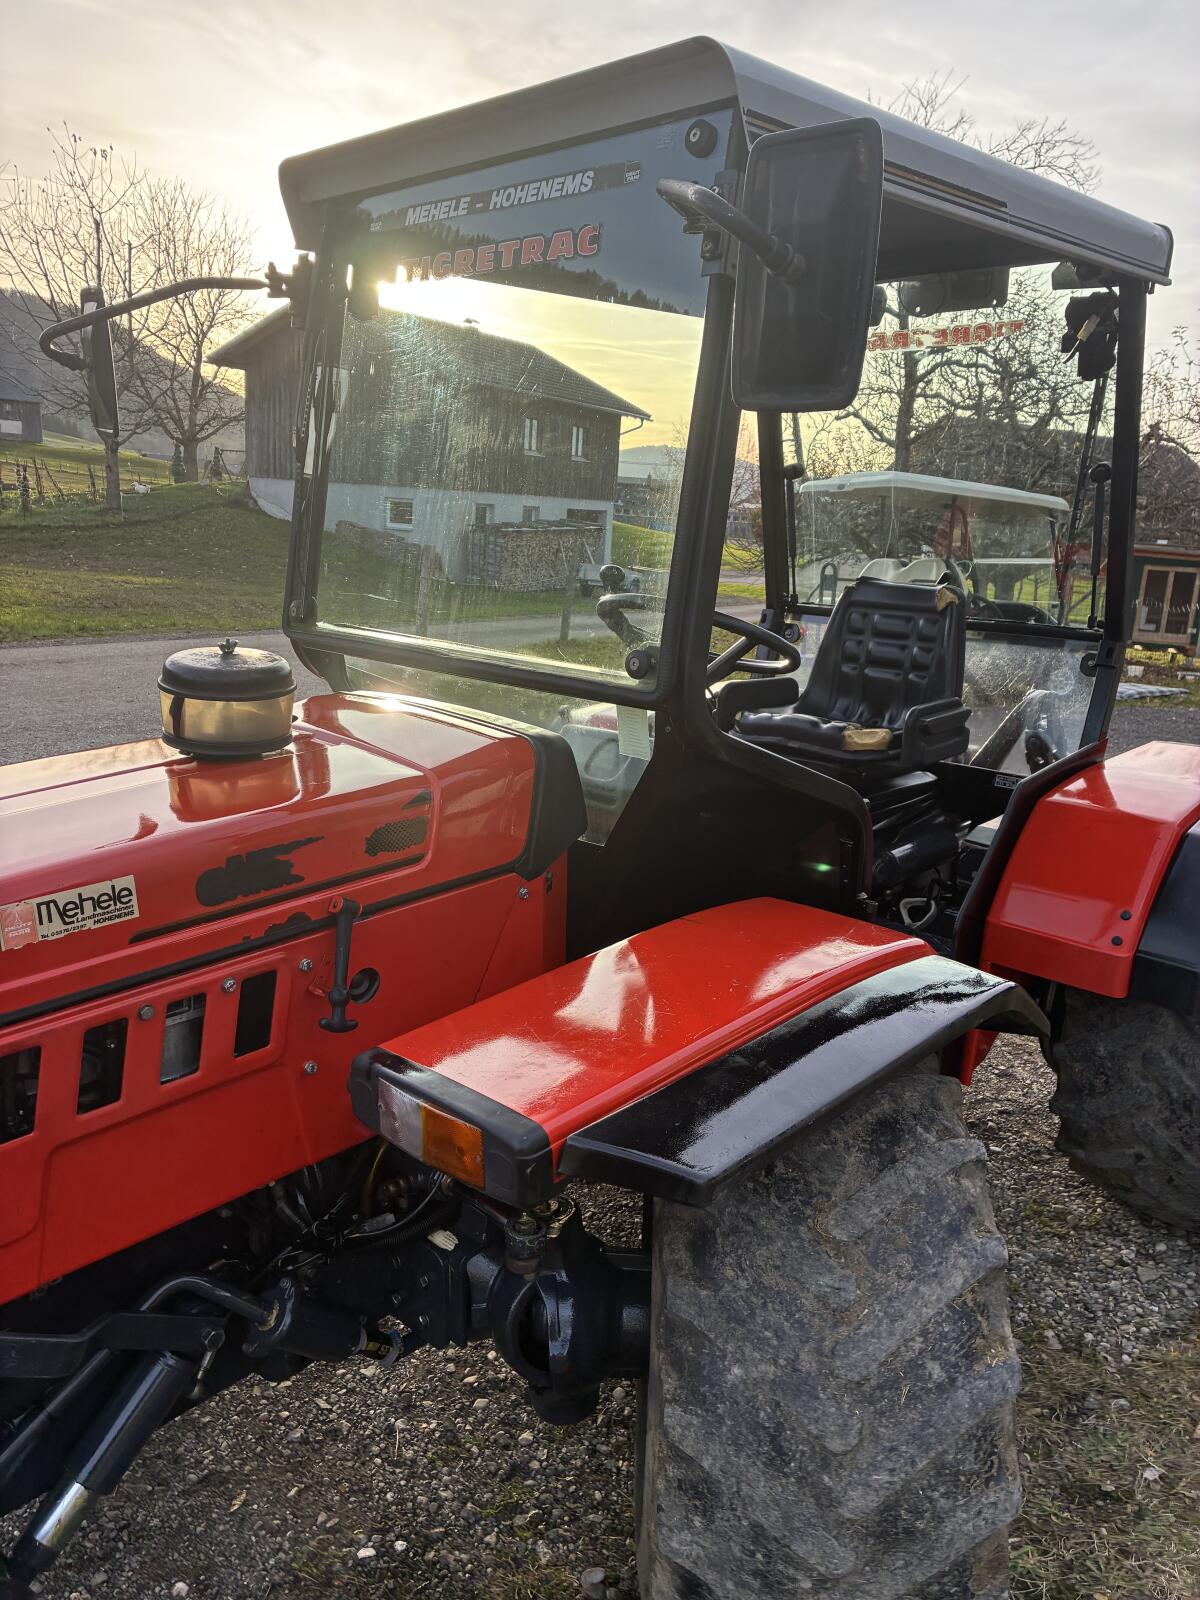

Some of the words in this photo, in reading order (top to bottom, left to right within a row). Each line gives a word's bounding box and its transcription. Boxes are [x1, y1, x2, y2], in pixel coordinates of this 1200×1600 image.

[405, 197, 471, 226] MEHELE
[489, 171, 594, 209] HOHENEMS
[400, 225, 601, 281] TIGRETRAC
[36, 885, 133, 925] Mehele
[75, 904, 134, 923] Landmaschinen
[93, 910, 135, 926] HOHENEMS
